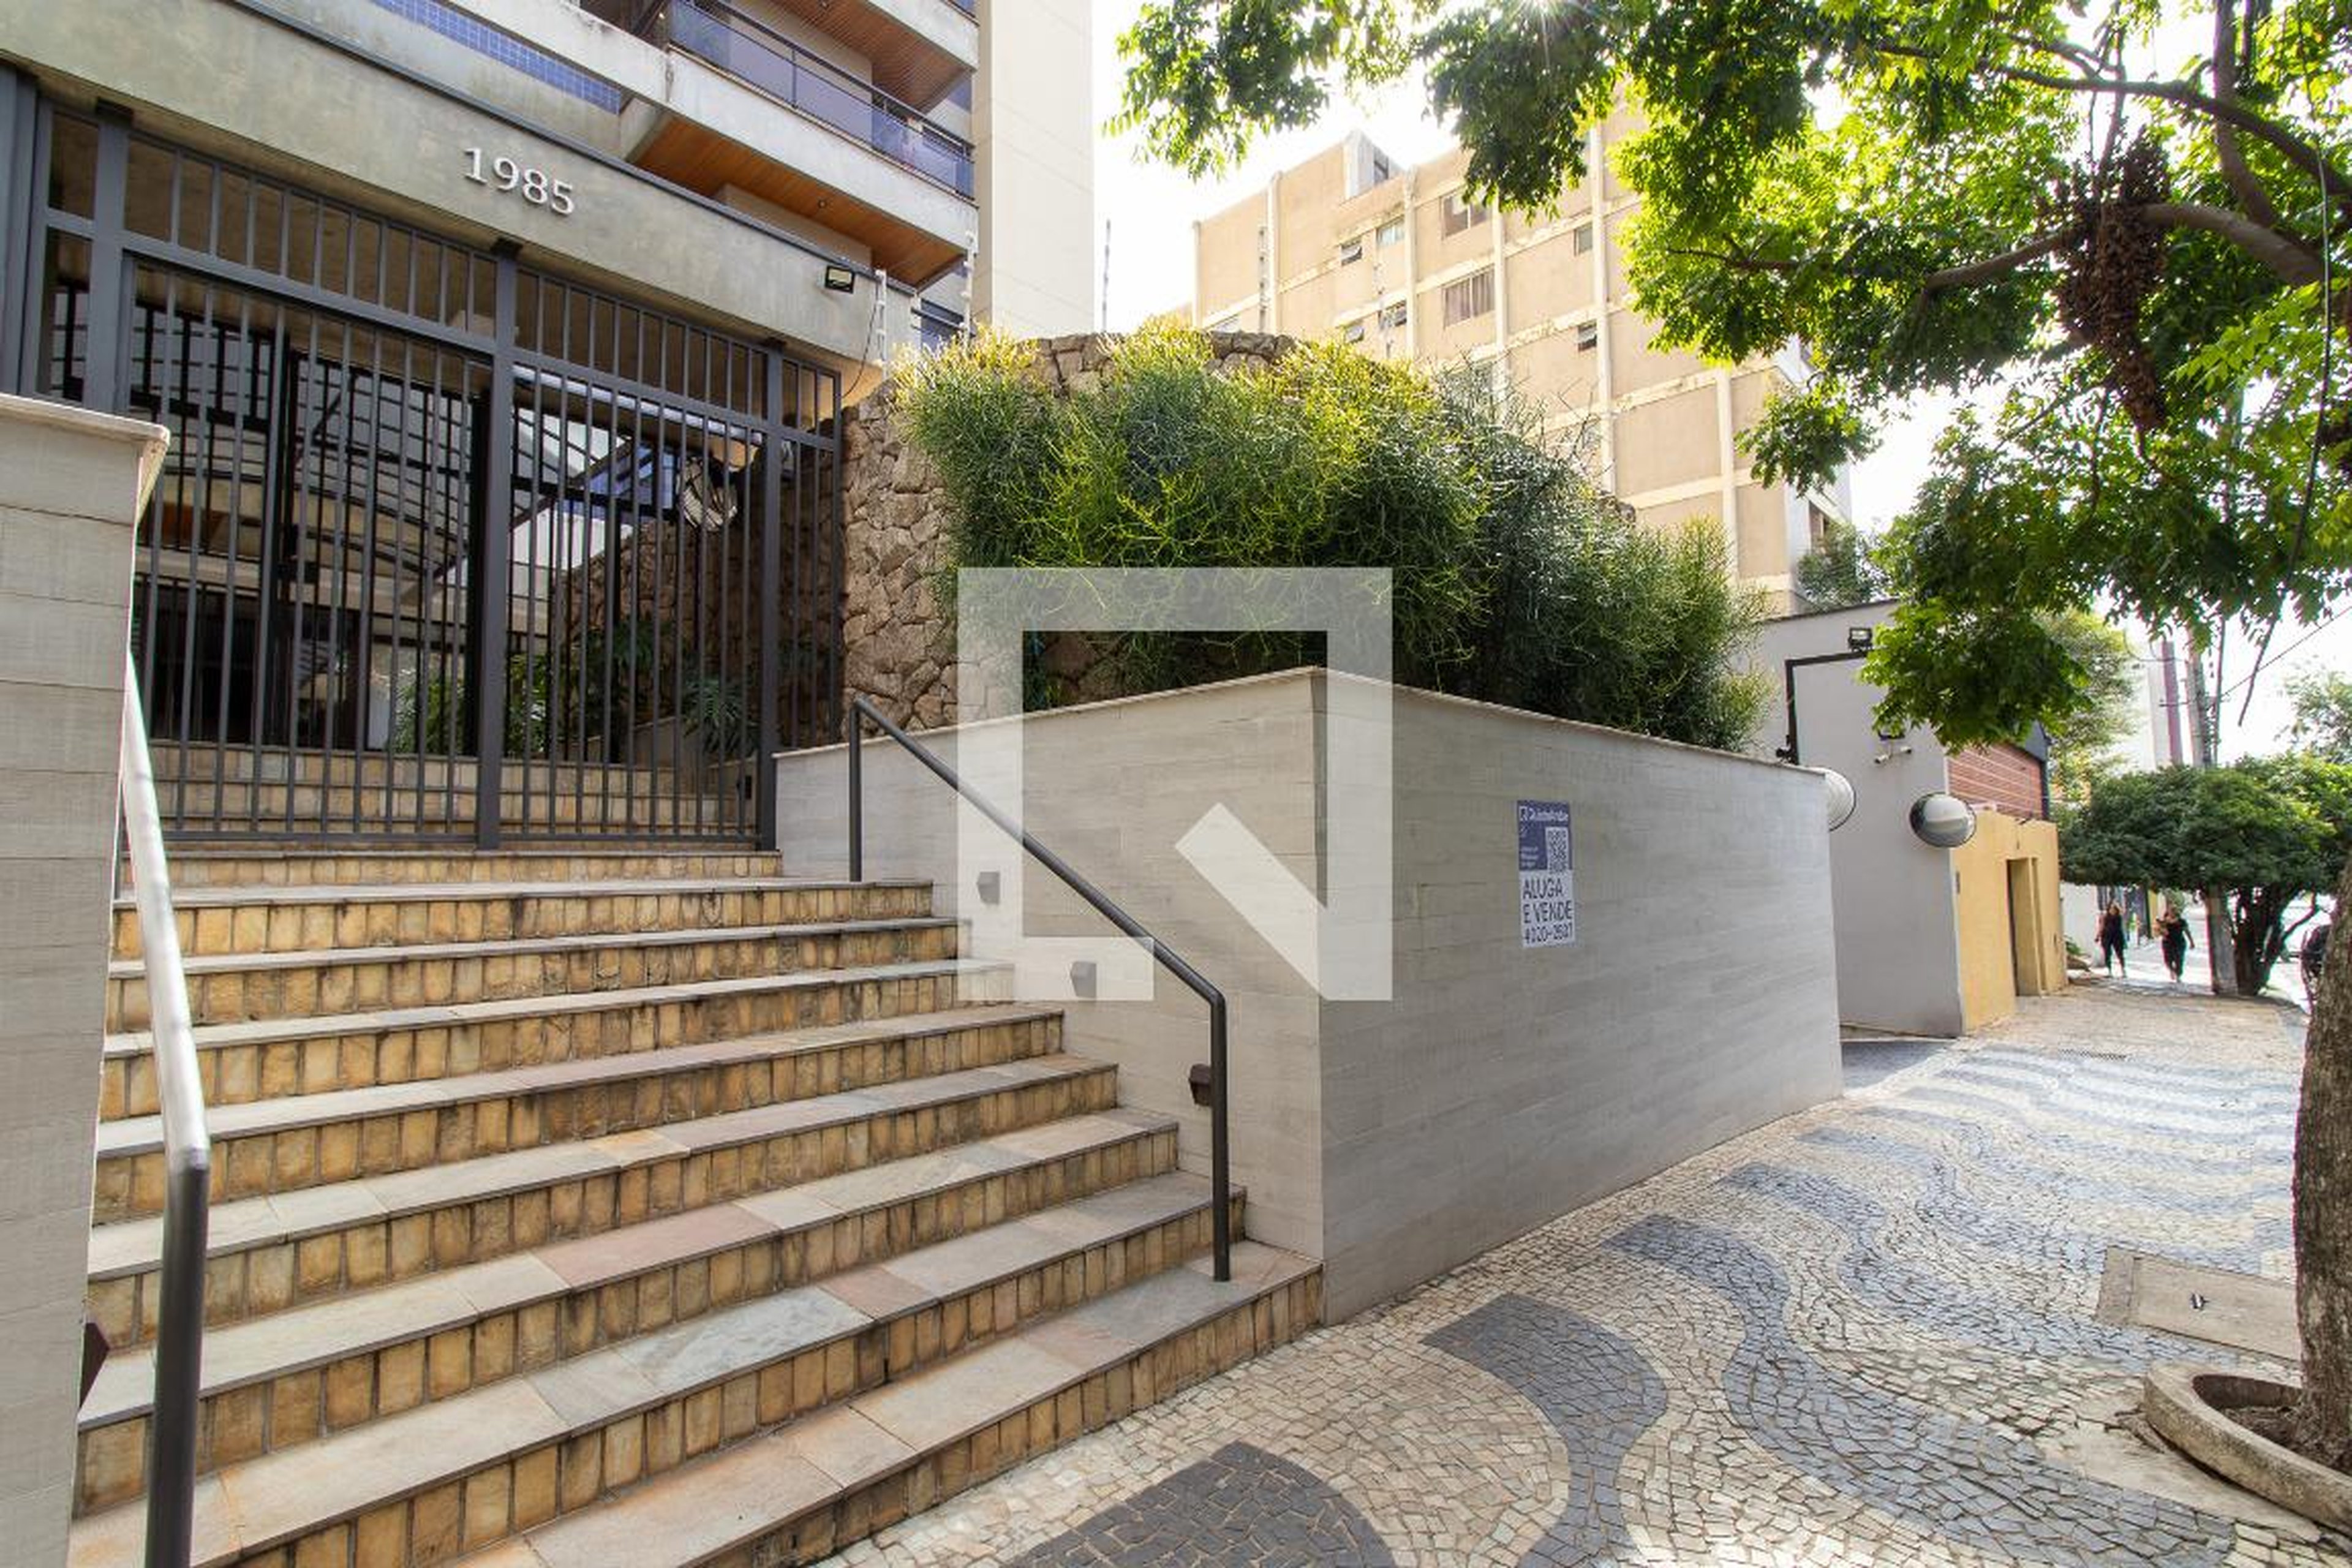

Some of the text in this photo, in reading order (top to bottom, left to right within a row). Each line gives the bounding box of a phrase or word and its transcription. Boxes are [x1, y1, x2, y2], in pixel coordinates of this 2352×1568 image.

[464, 147, 575, 215] 1985
[1523, 878, 1563, 899] ALUGA
[1523, 900, 1572, 923] E VENDE
